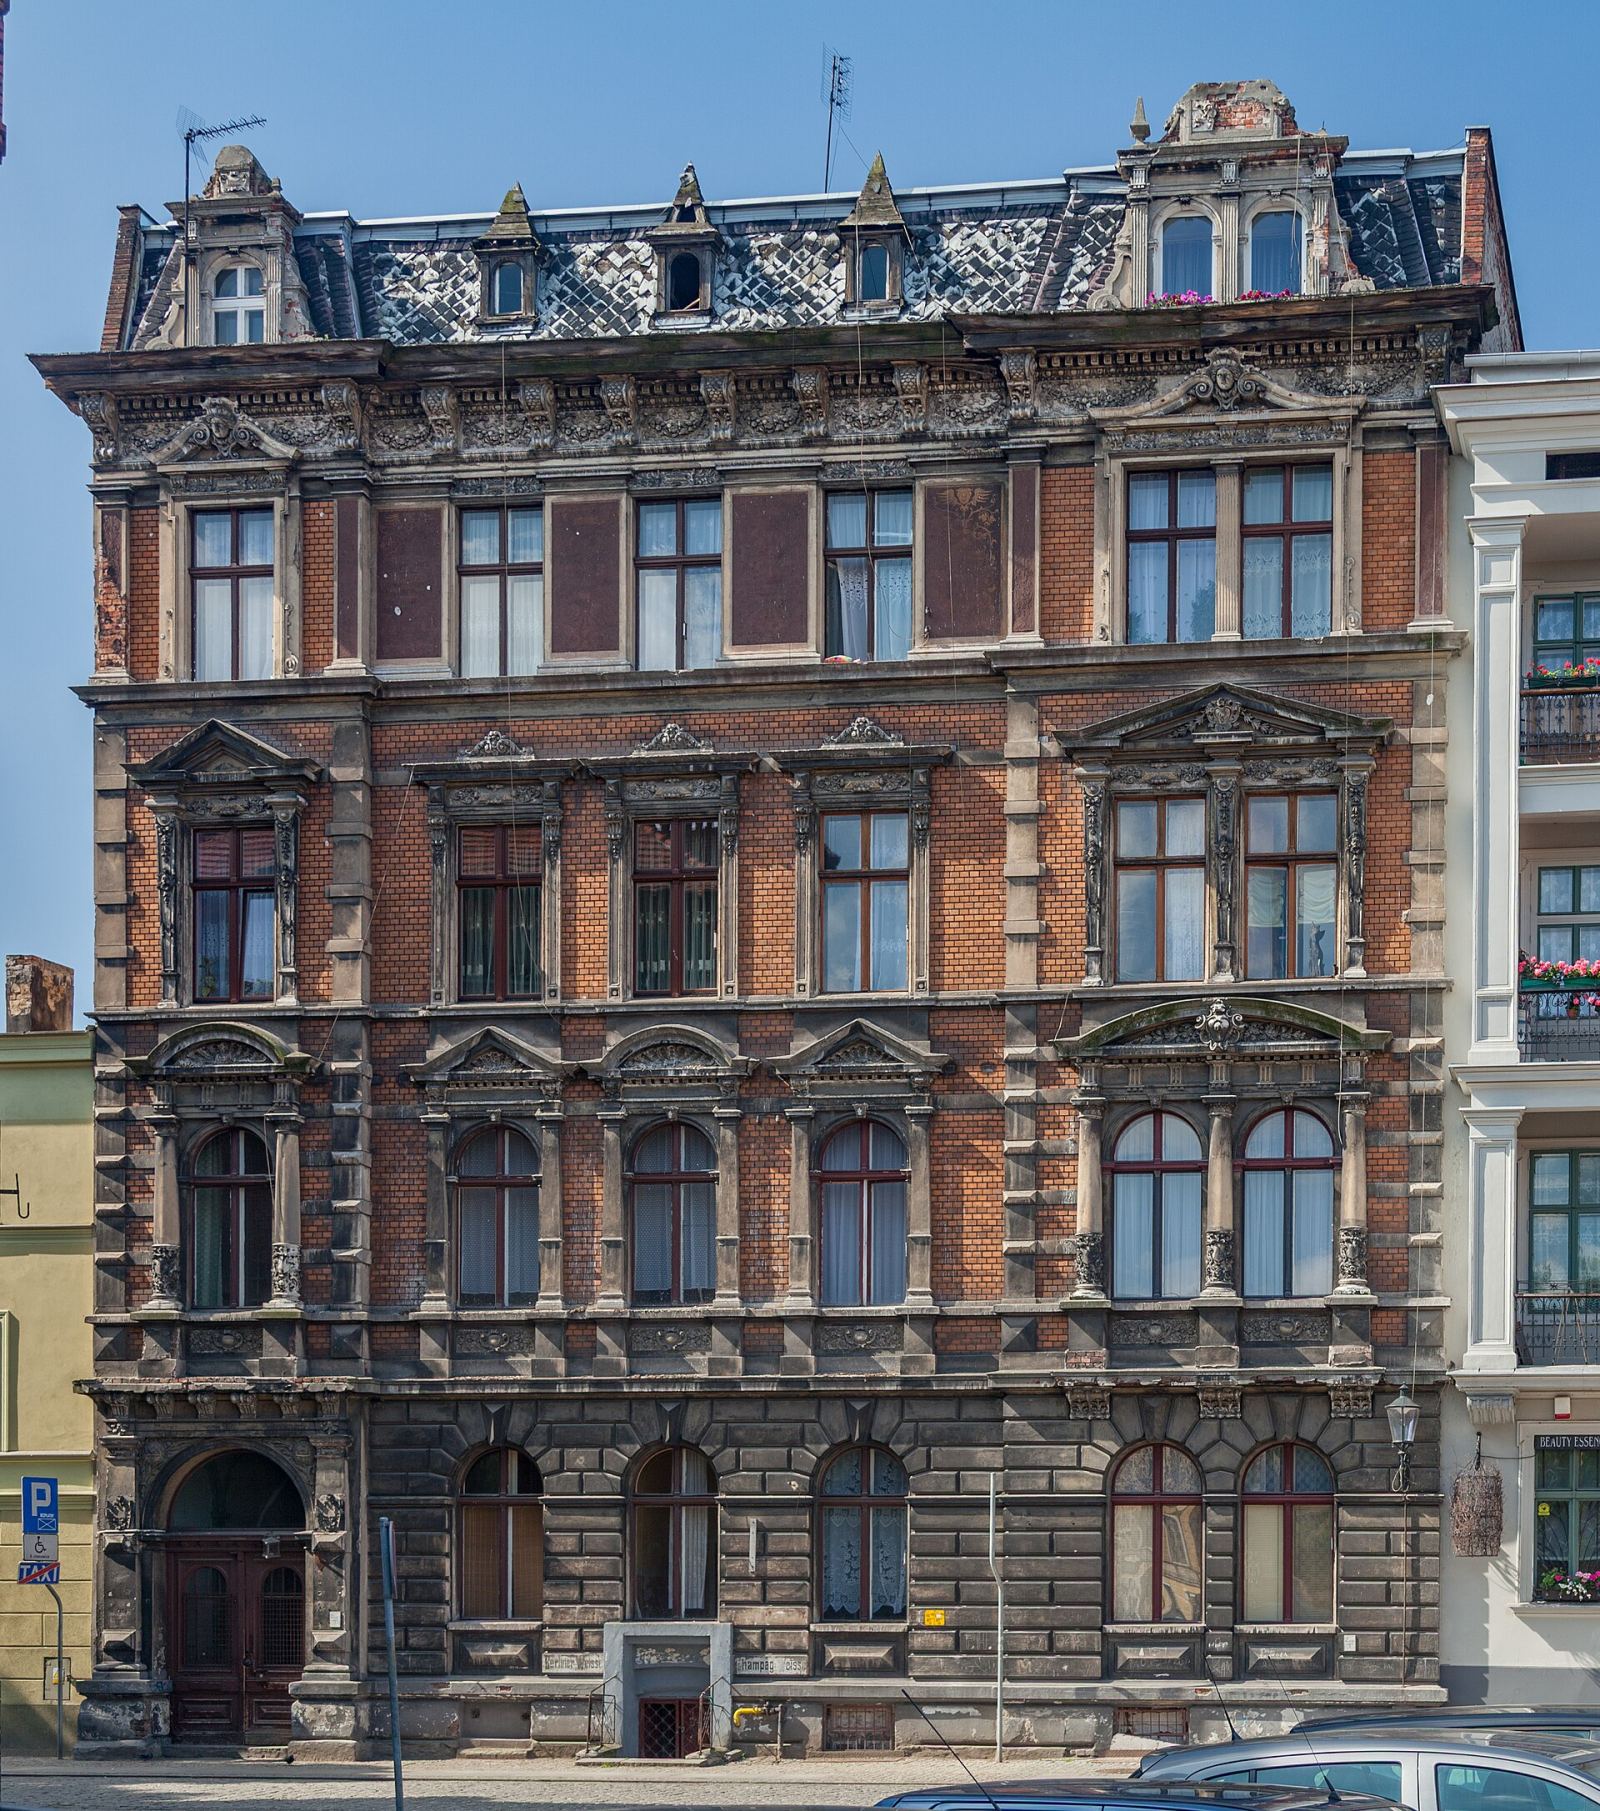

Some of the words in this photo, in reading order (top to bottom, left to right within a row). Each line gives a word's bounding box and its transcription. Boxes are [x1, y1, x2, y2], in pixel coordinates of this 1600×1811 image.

[1540, 1436, 1571, 1448] BEAUTY
[31, 1482, 51, 1517] P
[20, 1565, 58, 1582] TAXI
